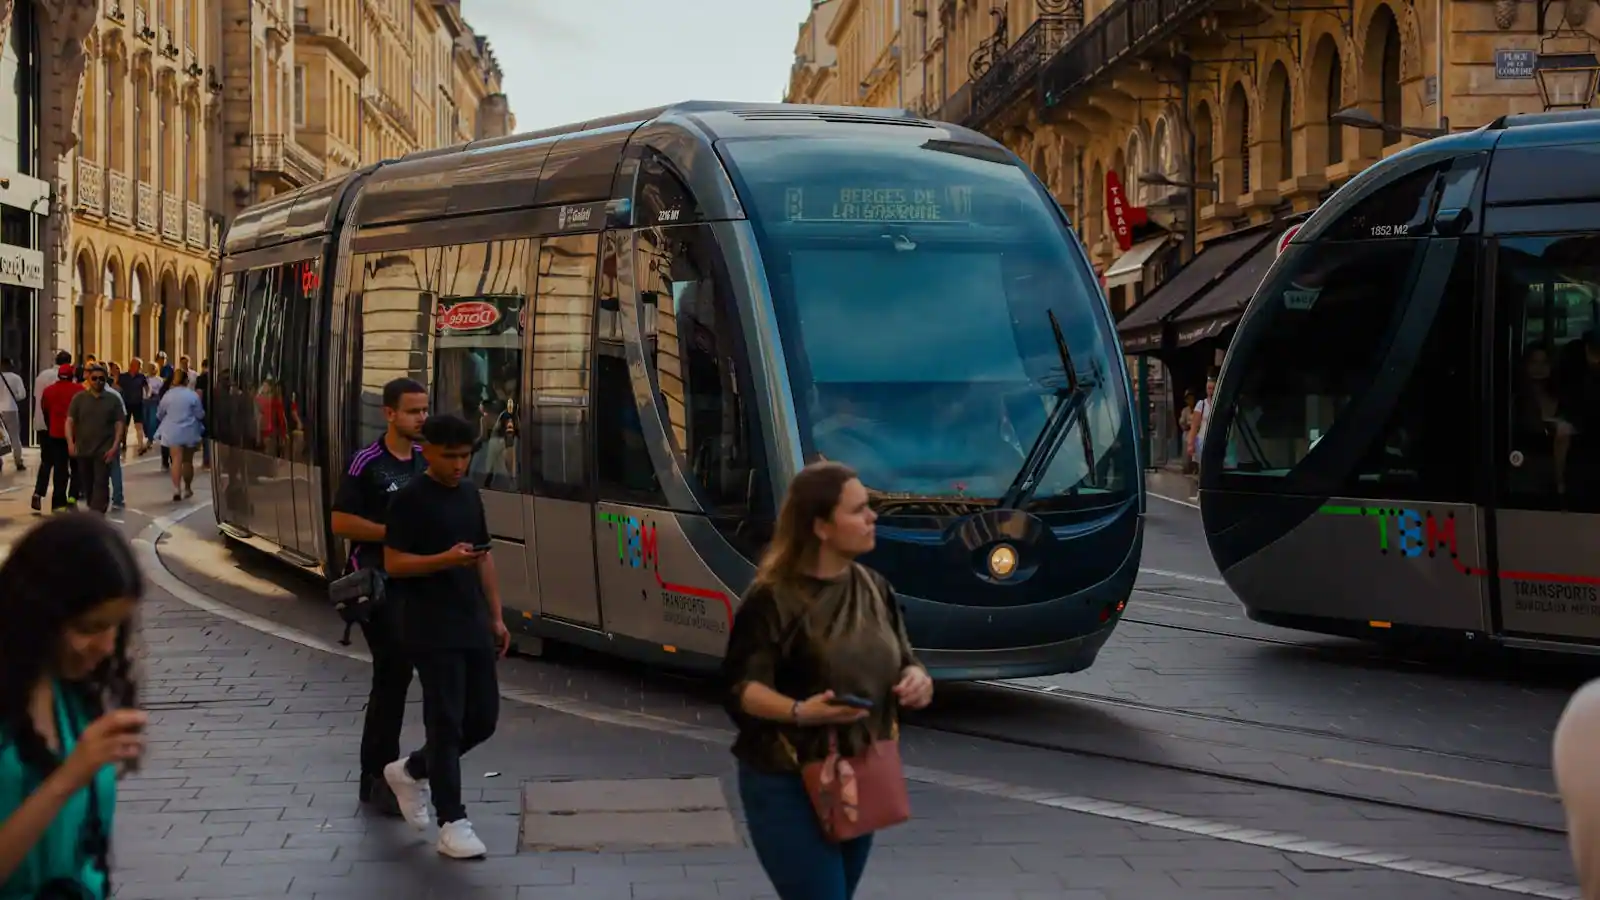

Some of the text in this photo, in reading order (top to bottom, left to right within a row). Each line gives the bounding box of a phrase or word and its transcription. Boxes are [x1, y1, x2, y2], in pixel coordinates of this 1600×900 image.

[1504, 53, 1527, 61] PLACE
[840, 188, 936, 203] BERGES DE
[1110, 187, 1127, 235] TABAC
[1370, 224, 1409, 236] 1852 M2
[603, 513, 660, 569] TBM
[1352, 505, 1458, 558] TBM
[661, 591, 707, 615] TRANSPORTS
[1512, 580, 1598, 603] TRANSPORTS
